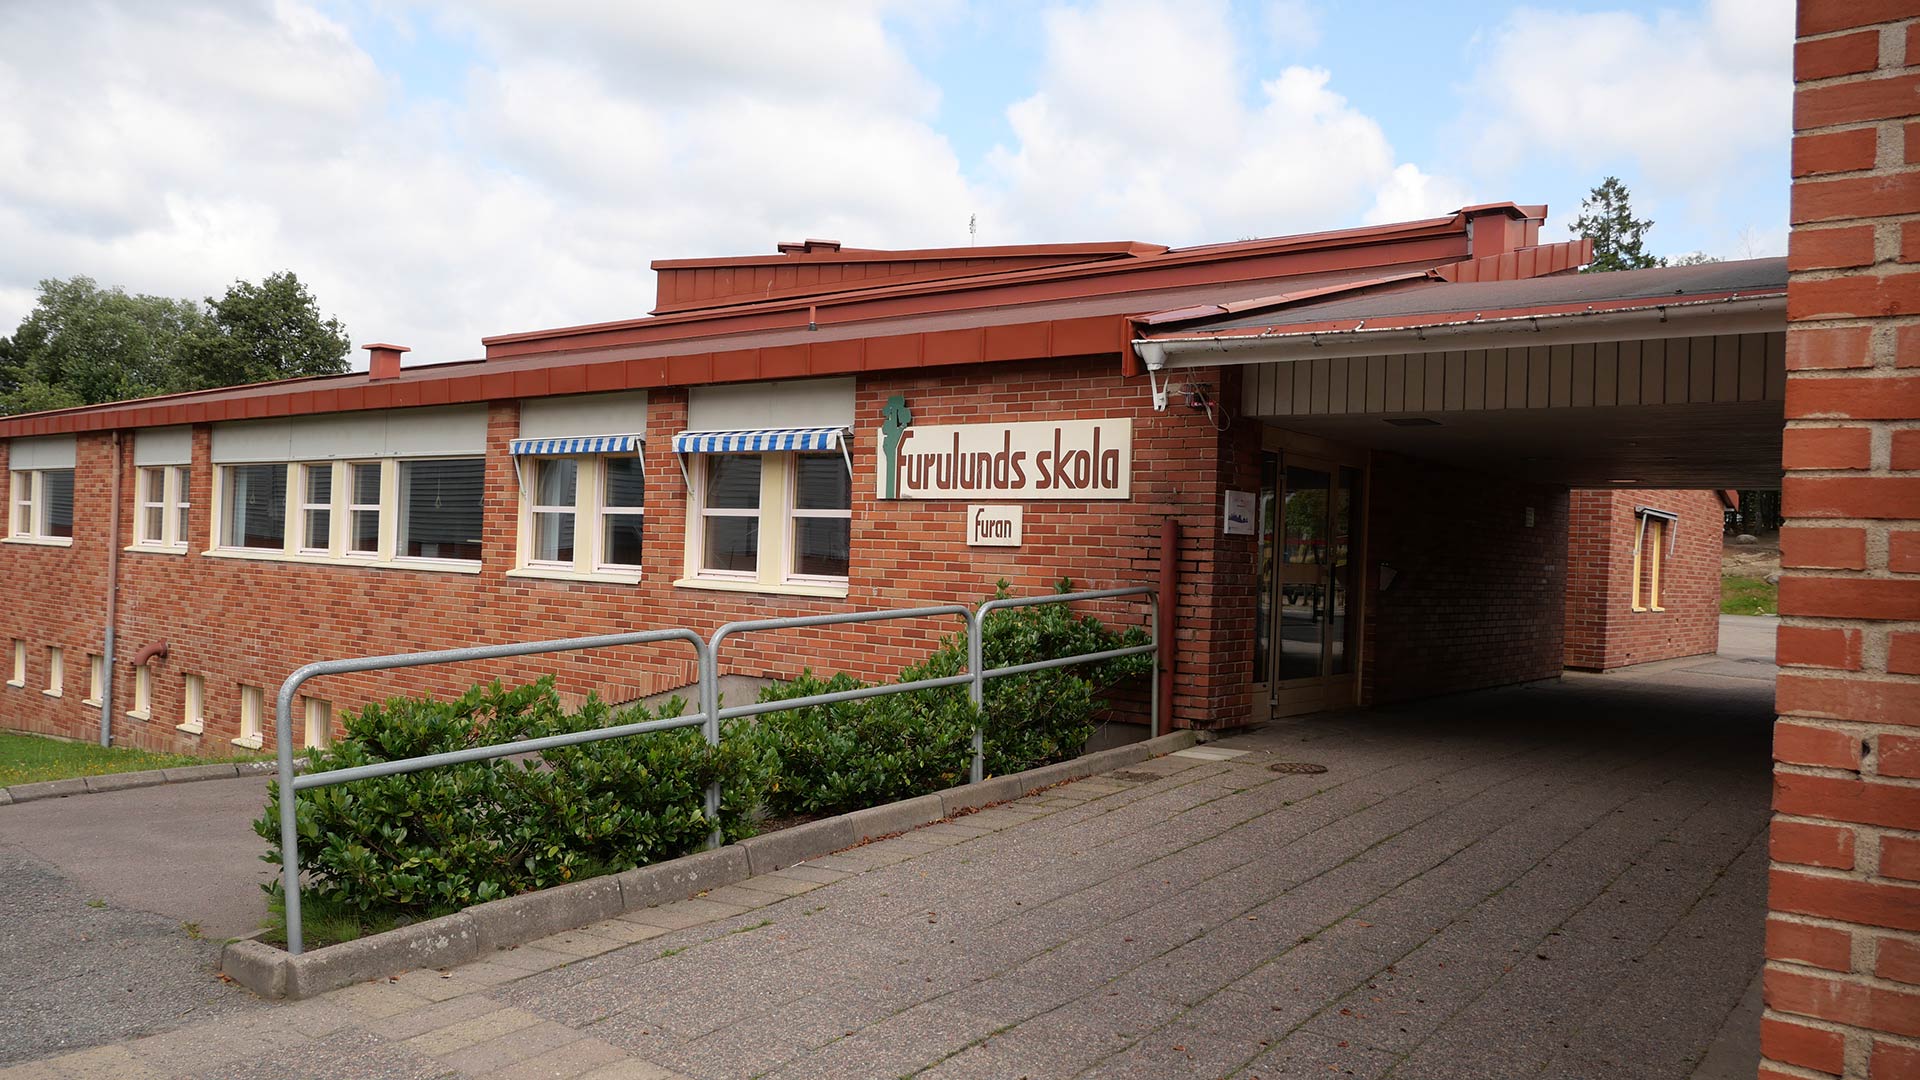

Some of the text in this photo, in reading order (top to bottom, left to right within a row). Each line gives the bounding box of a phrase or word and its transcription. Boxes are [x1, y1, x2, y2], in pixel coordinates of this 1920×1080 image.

[896, 426, 1119, 499] furulunds skola
[974, 508, 1012, 542] furan
